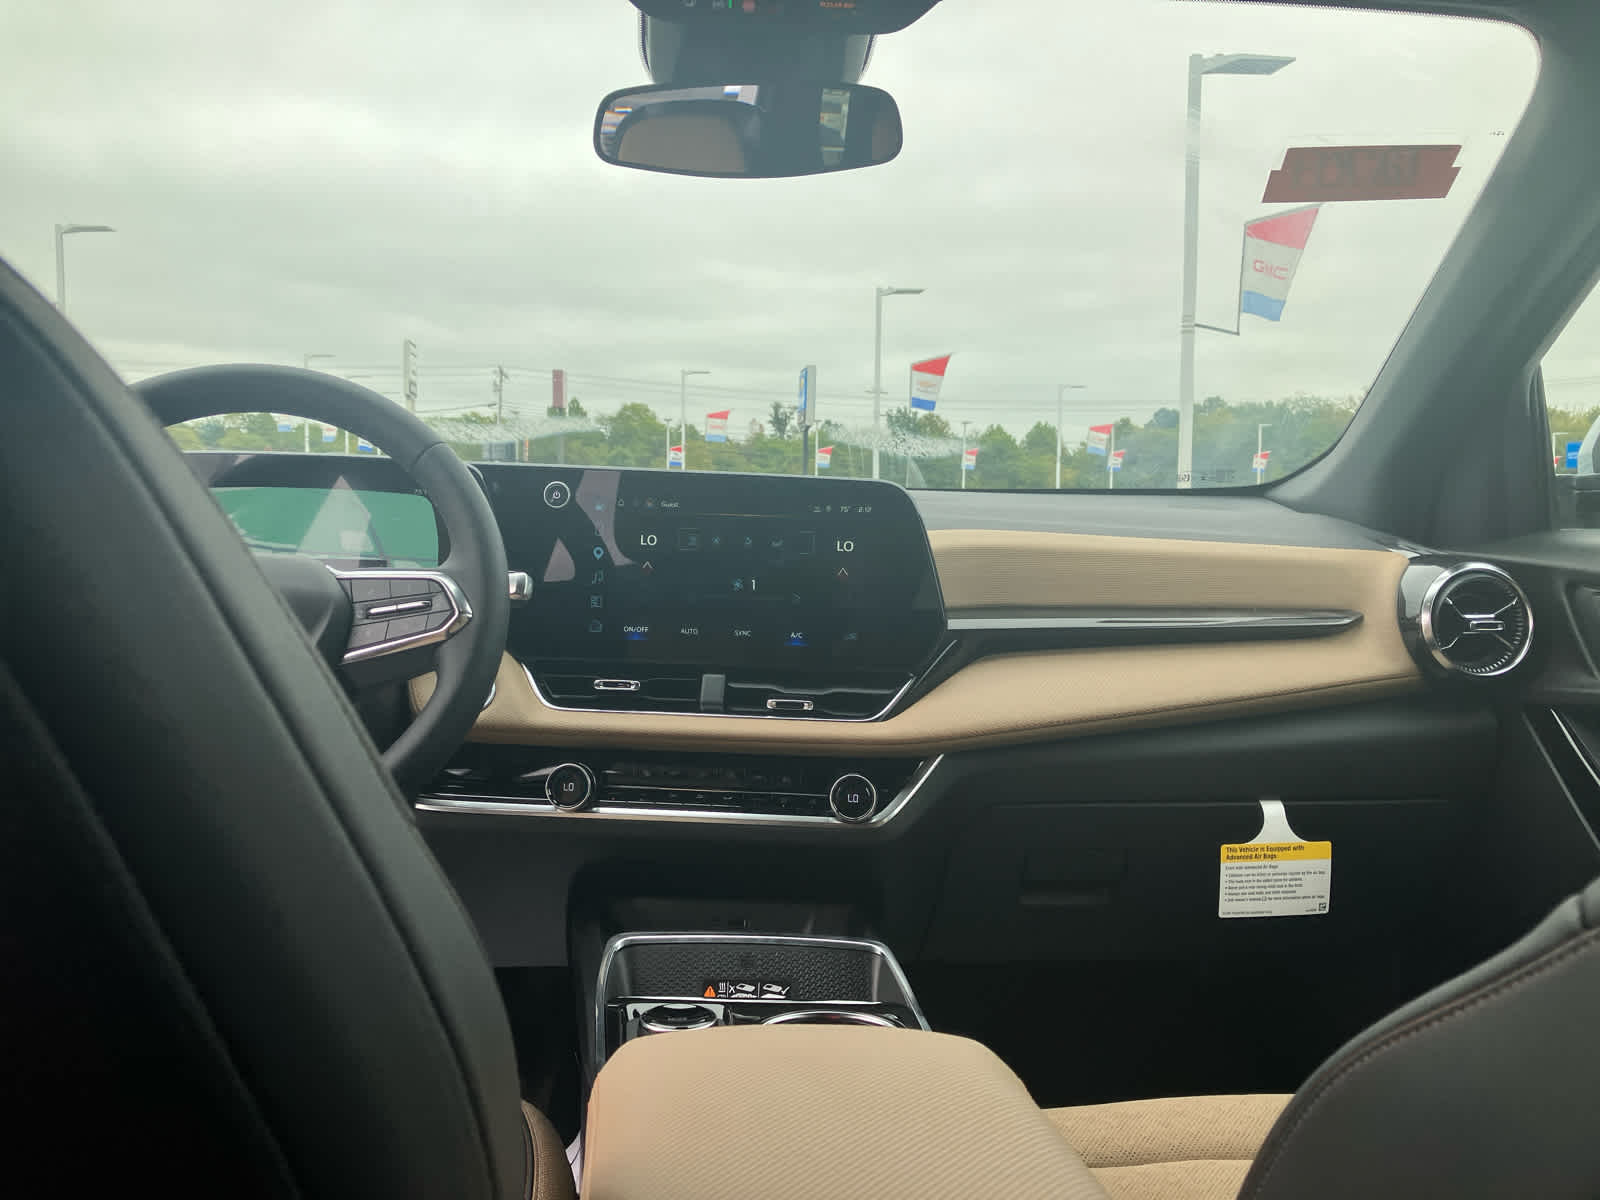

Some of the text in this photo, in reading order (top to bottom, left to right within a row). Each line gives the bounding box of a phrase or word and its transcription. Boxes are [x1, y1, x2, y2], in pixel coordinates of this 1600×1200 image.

[1253, 259, 1288, 280] GMC
[640, 534, 657, 546] LO
[836, 540, 854, 552] LO
[751, 579, 756, 591] 1
[680, 628, 699, 636] AUTO
[734, 629, 752, 637] SYNC
[563, 782, 575, 792] LO
[847, 793, 859, 803] LO
[1266, 845, 1291, 853] Equipped
